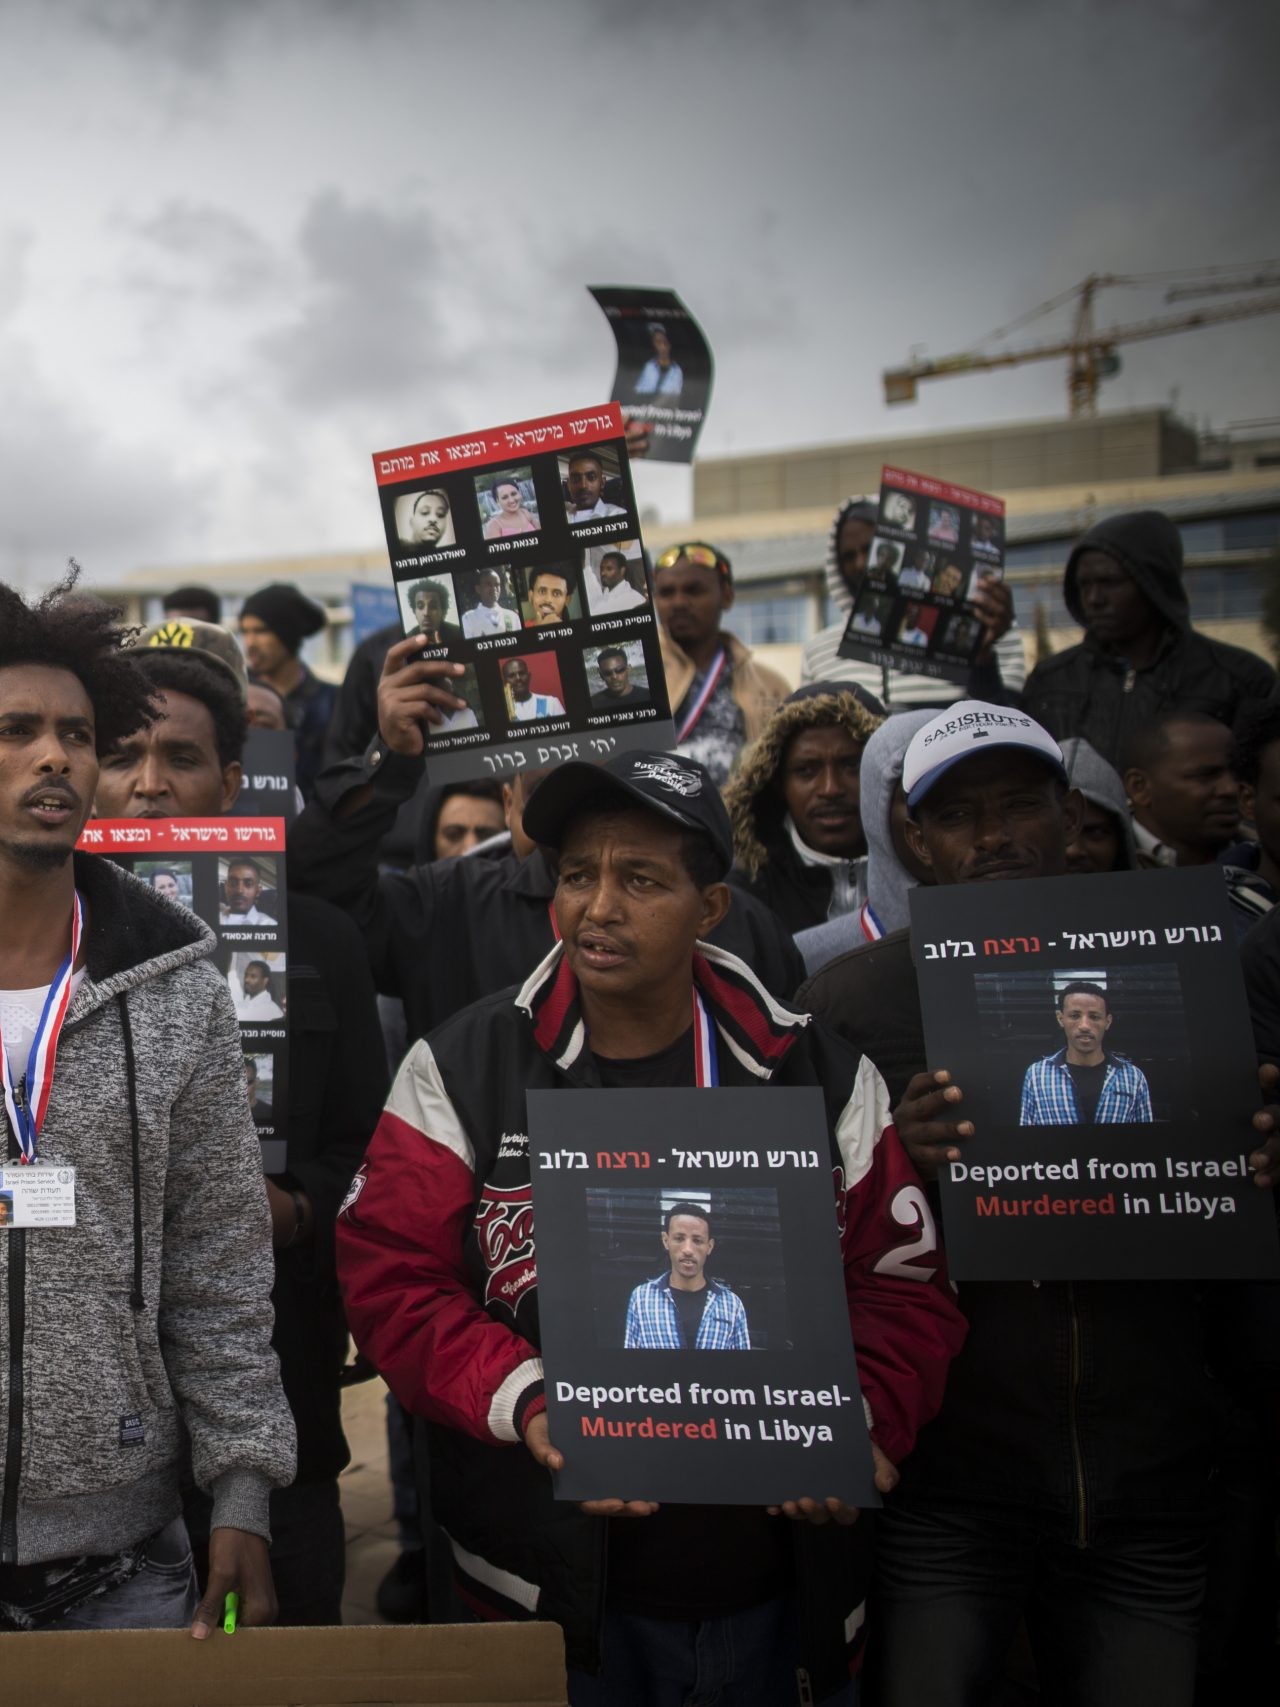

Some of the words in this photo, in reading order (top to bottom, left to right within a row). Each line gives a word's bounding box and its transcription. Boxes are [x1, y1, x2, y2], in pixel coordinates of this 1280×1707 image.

[569, 413, 613, 437] גורשו
[505, 423, 564, 448] מישראל
[420, 450, 441, 466] את
[446, 440, 487, 461] ומצאו
[380, 456, 415, 475] מותם
[924, 712, 1032, 746] SARISHUT'S
[537, 742, 579, 764] זכרם
[590, 736, 616, 754] יהי
[483, 751, 527, 773] ברוך
[253, 773, 288, 791] גורש
[82, 829, 103, 843] את
[110, 828, 151, 843] ומצאו
[170, 824, 228, 841] מישראל
[234, 827, 276, 841] גורשו
[1062, 929, 1156, 950] מישראל
[1164, 924, 1222, 944] גורש
[924, 938, 976, 959] בלוב
[983, 936, 1040, 955] נרצח
[539, 1149, 589, 1169] בלוב
[596, 1150, 651, 1169] נרצח
[671, 1148, 759, 1168] מישראל
[767, 1150, 819, 1168] גורש
[950, 1158, 1079, 1187] Deported
[1086, 1157, 1157, 1180] from
[975, 1193, 1116, 1217] Murdered
[1123, 1192, 1150, 1215] in
[1159, 1190, 1236, 1220] Libya
[873, 1185, 937, 1282] 2
[555, 1381, 682, 1409] Deported
[688, 1382, 756, 1405] from
[763, 1384, 851, 1407] Israel-
[580, 1416, 718, 1440] Murdered
[724, 1418, 751, 1441] in
[758, 1419, 834, 1448] Libya
